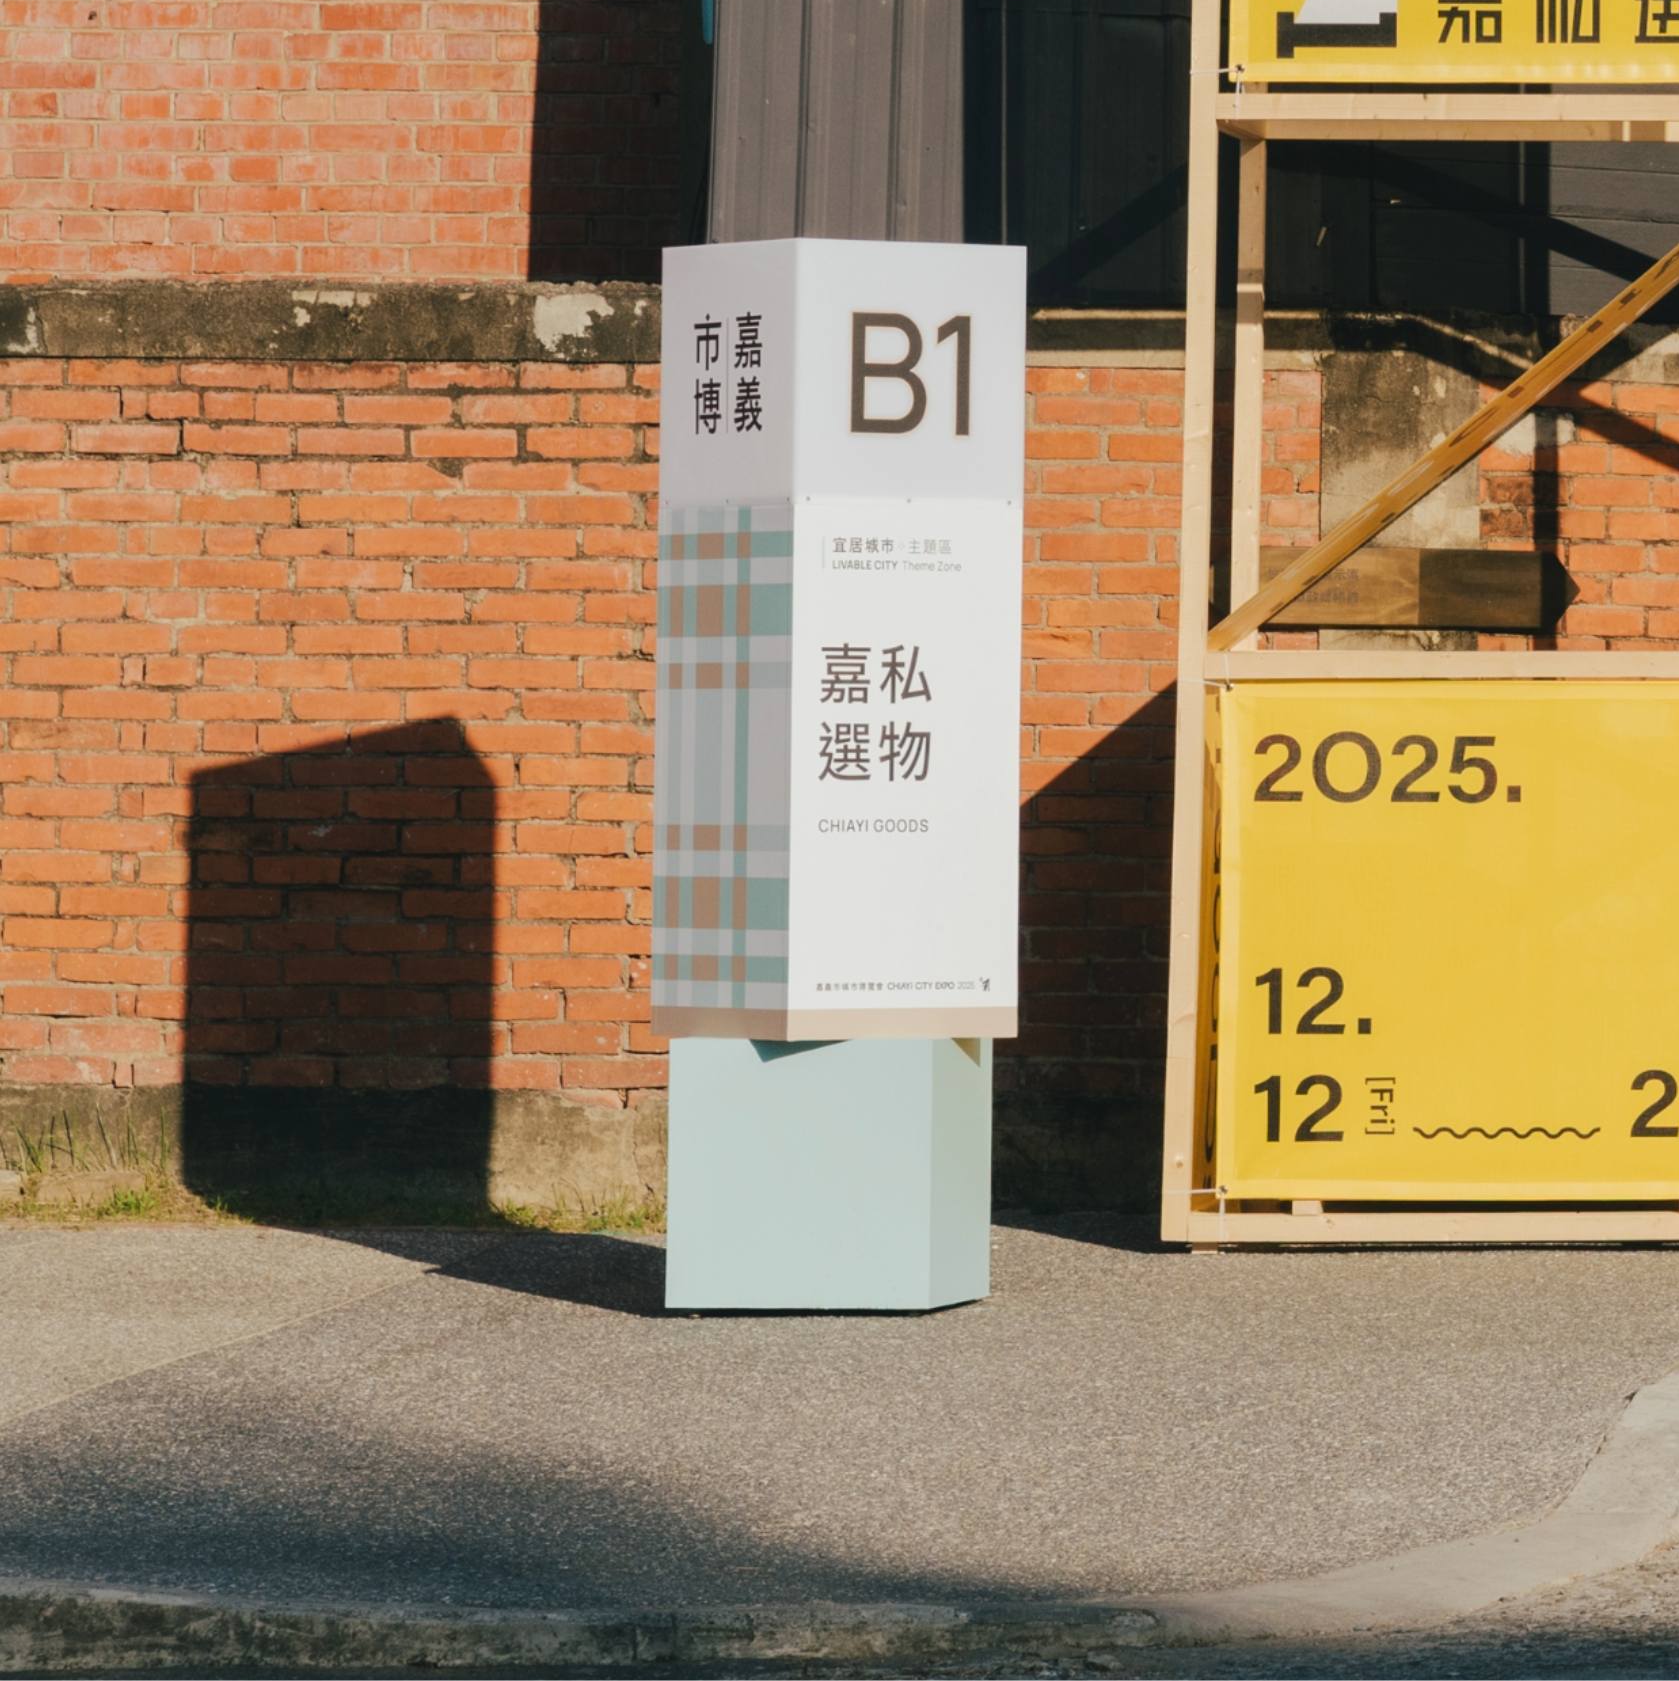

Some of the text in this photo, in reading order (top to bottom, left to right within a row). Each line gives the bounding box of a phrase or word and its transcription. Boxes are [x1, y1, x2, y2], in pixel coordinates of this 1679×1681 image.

[694, 314, 722, 435] 市博
[733, 311, 763, 433] 嘉義
[850, 311, 971, 436] B1
[831, 559, 873, 571] LIVABLE
[874, 559, 899, 571] CITY
[832, 536, 895, 554] 宜居城市
[820, 643, 933, 705] 嘉私
[818, 721, 932, 783] 選物
[1254, 731, 1522, 804] 2025.
[817, 818, 930, 834] CHIAYI GOODS
[1255, 966, 1372, 1035] 12.
[1254, 1074, 1344, 1143] 12
[1364, 1077, 1396, 1135] [Fri]
